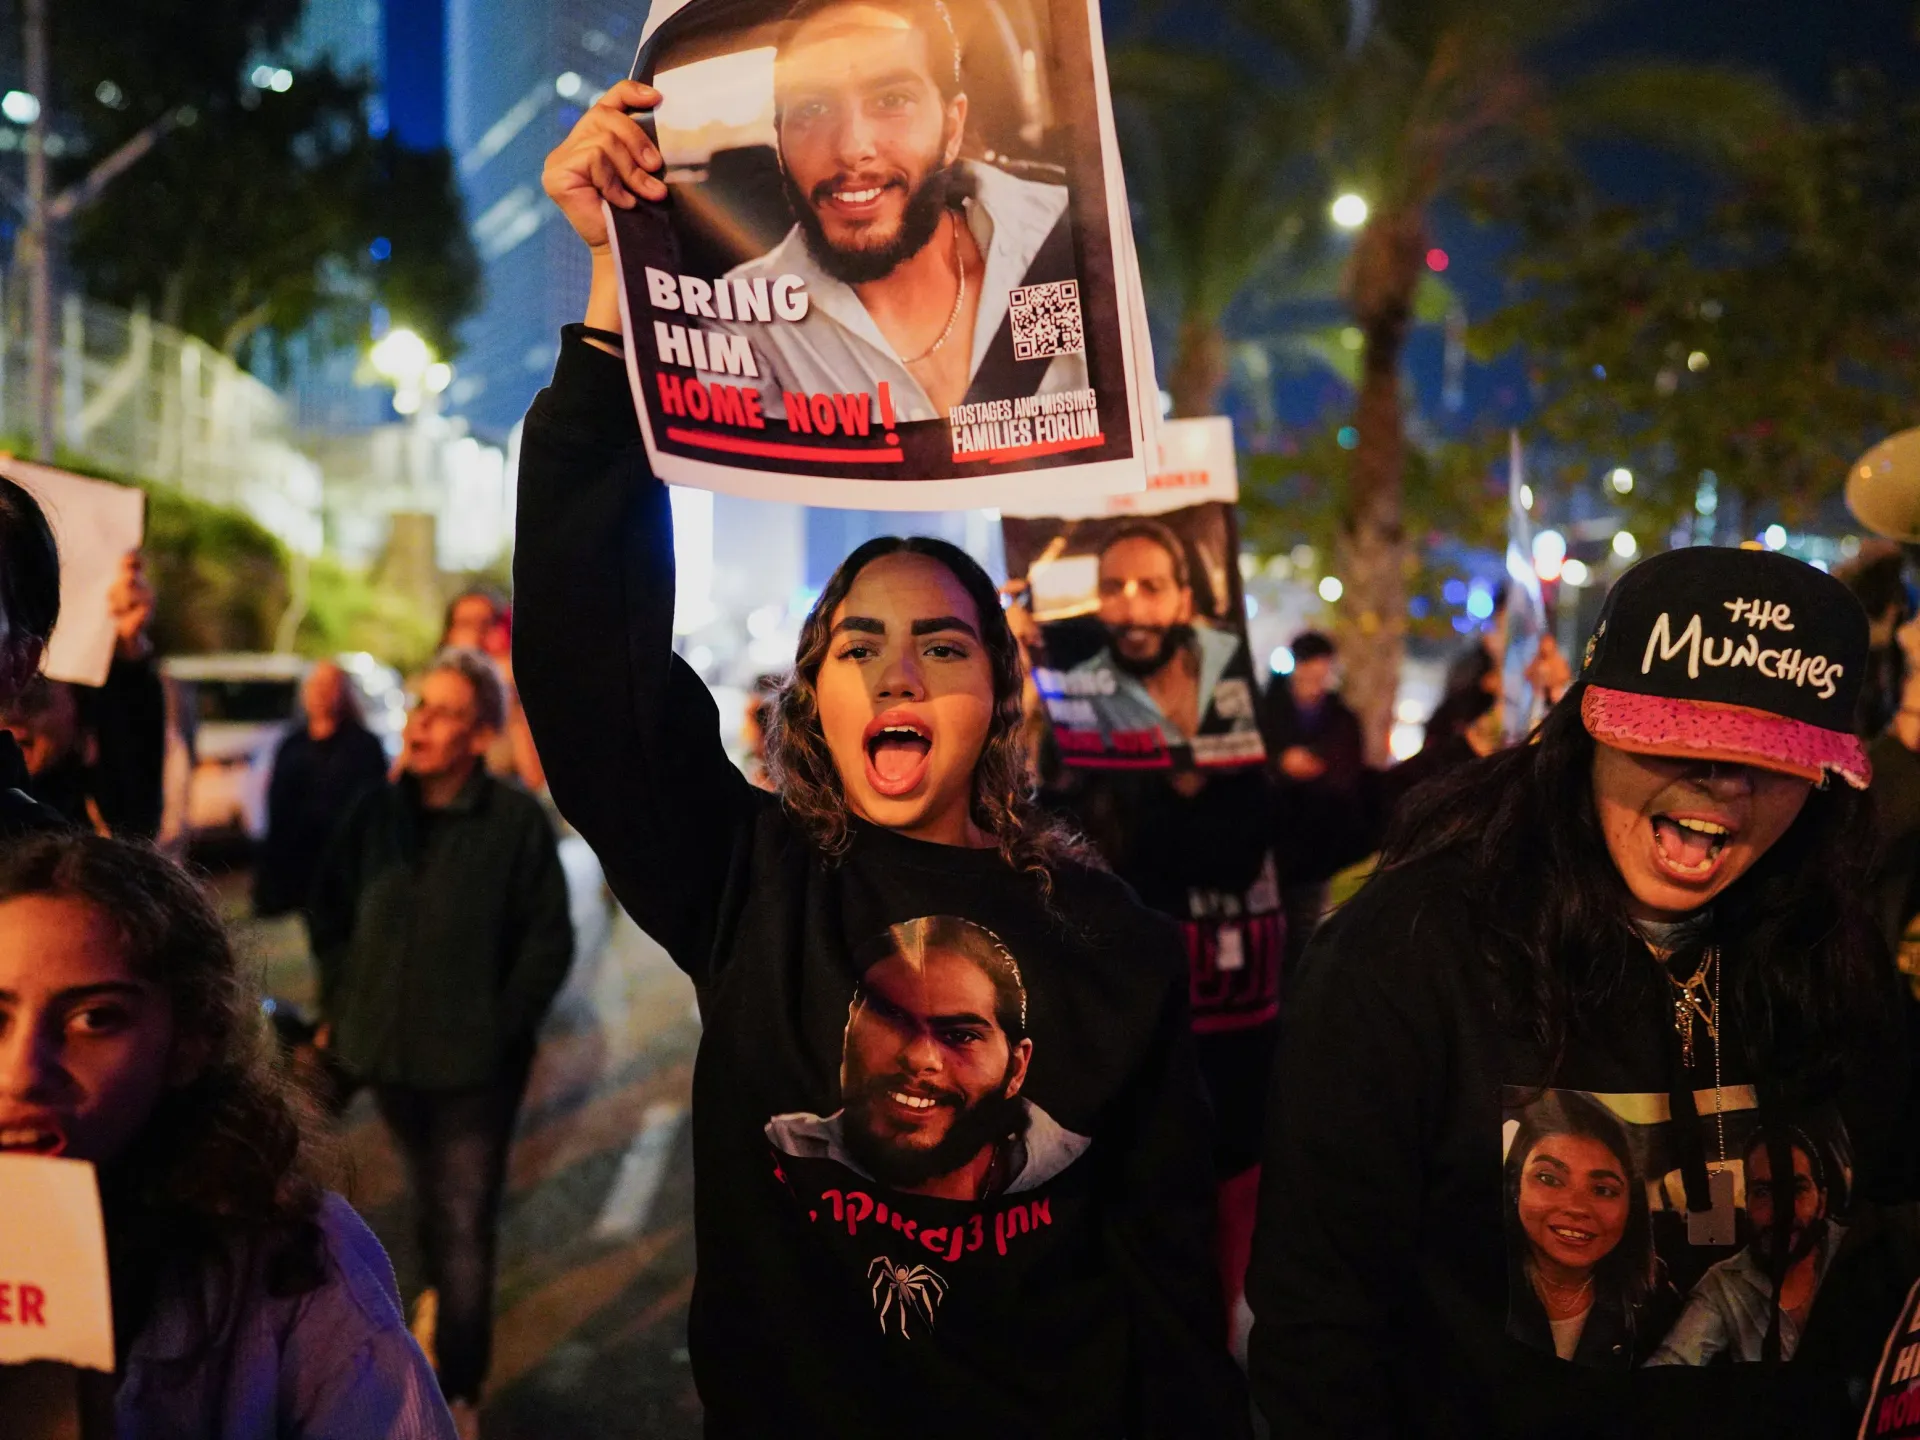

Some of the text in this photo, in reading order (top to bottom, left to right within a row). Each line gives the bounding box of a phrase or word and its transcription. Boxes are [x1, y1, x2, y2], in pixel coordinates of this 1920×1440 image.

[645, 266, 809, 323] BRING
[653, 320, 759, 378] HIM
[656, 371, 900, 446] HOME NOW!
[948, 387, 1097, 427] HOSTAGES AND MISSING
[951, 408, 1101, 455] FAMILIES FORUM
[994, 1195, 1053, 1257] מתן
